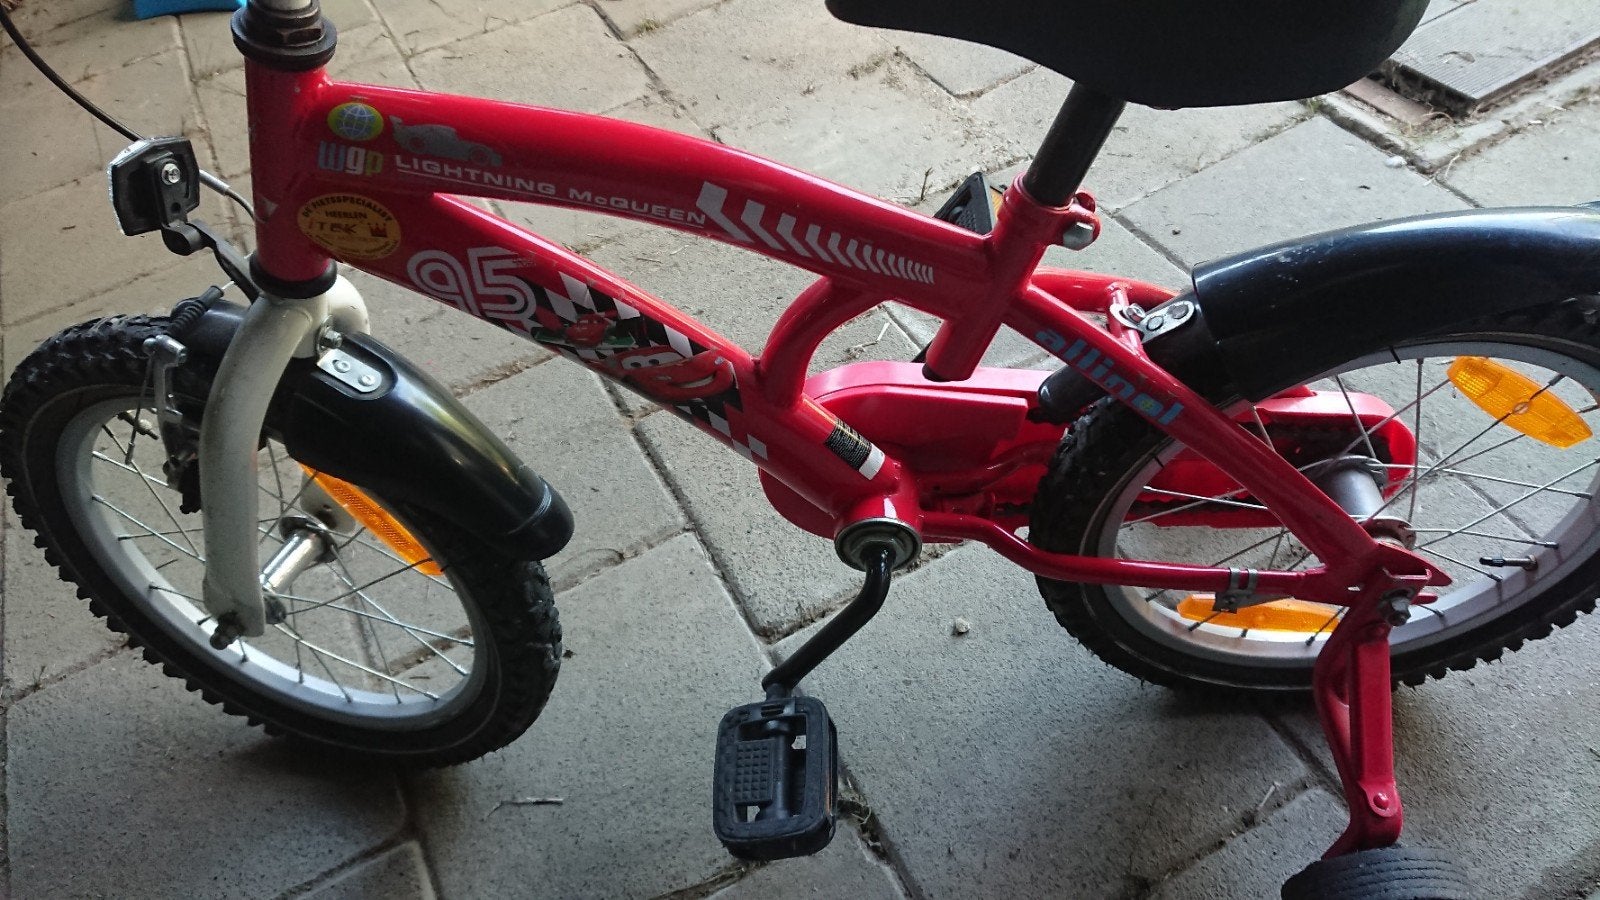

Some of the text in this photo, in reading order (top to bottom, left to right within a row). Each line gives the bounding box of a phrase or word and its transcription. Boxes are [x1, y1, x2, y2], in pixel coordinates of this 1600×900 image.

[318, 141, 384, 175] wgp
[395, 154, 706, 225] LIGHTNING McQUEEN
[406, 246, 538, 322] 95
